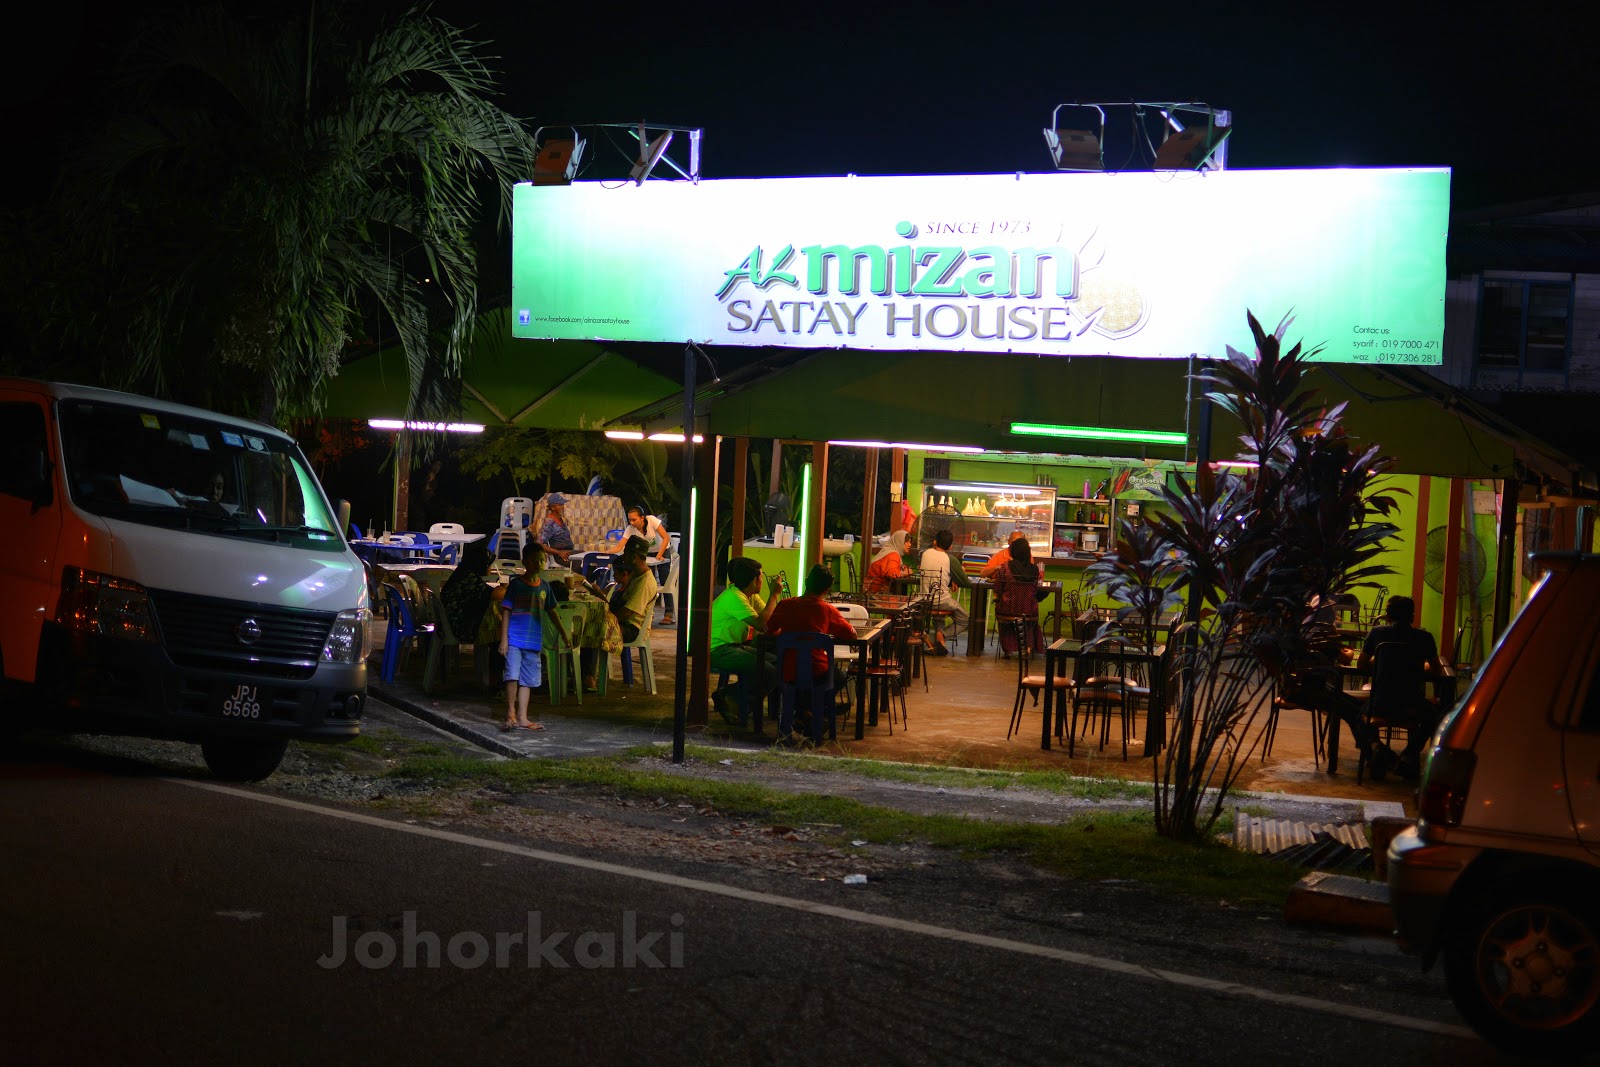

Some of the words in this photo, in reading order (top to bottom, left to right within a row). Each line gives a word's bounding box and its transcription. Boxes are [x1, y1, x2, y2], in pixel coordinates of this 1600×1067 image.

[925, 221, 980, 235] SINCE
[989, 221, 1032, 234] 1973
[801, 221, 1081, 299] mizan
[726, 299, 868, 336] SATAY
[883, 302, 1073, 341] HOUSE
[1353, 325, 1379, 334] Contac
[1353, 339, 1374, 349] syarif
[1382, 339, 1399, 349] 019
[1400, 340, 1422, 349] 7000
[1424, 340, 1439, 350] 471
[1379, 352, 1395, 362] 019
[1397, 353, 1419, 362] 7306
[1421, 354, 1436, 363] 281
[231, 685, 257, 702] JPJ
[223, 700, 261, 719] 9568
